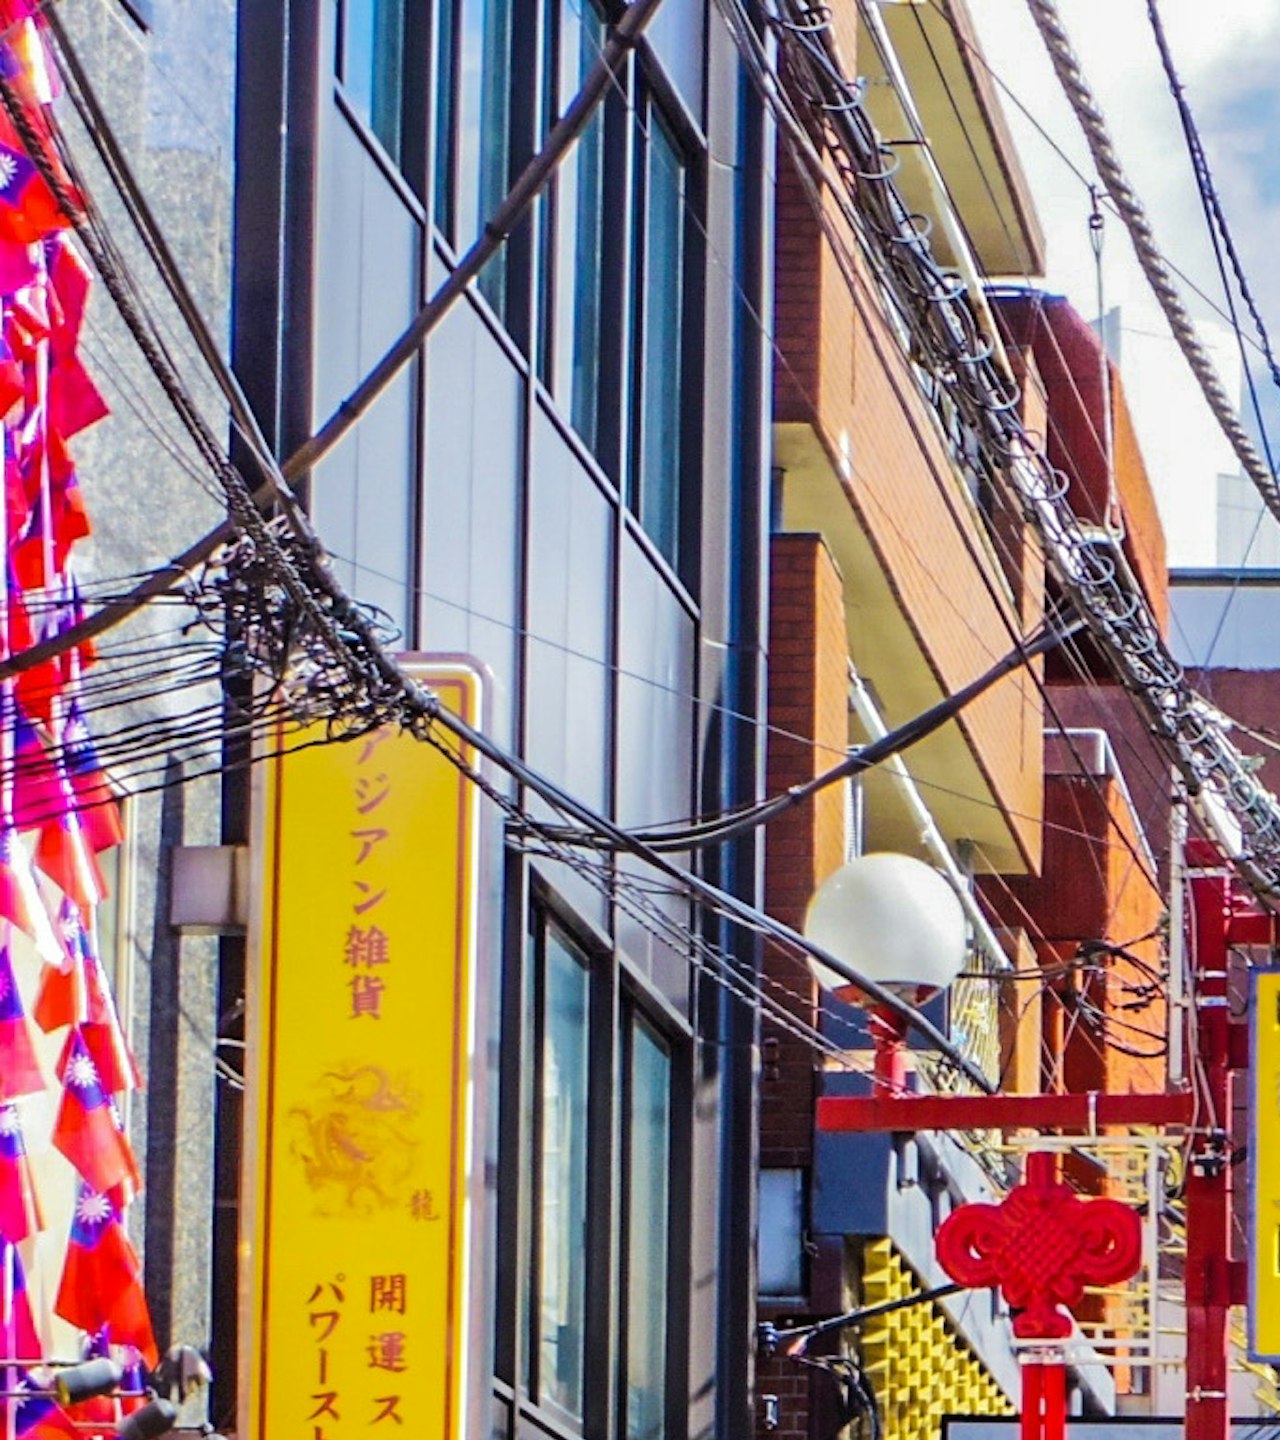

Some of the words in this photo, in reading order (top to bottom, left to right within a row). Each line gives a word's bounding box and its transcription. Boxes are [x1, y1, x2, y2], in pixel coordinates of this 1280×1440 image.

[343, 722, 393, 1021] アジアン雑貨
